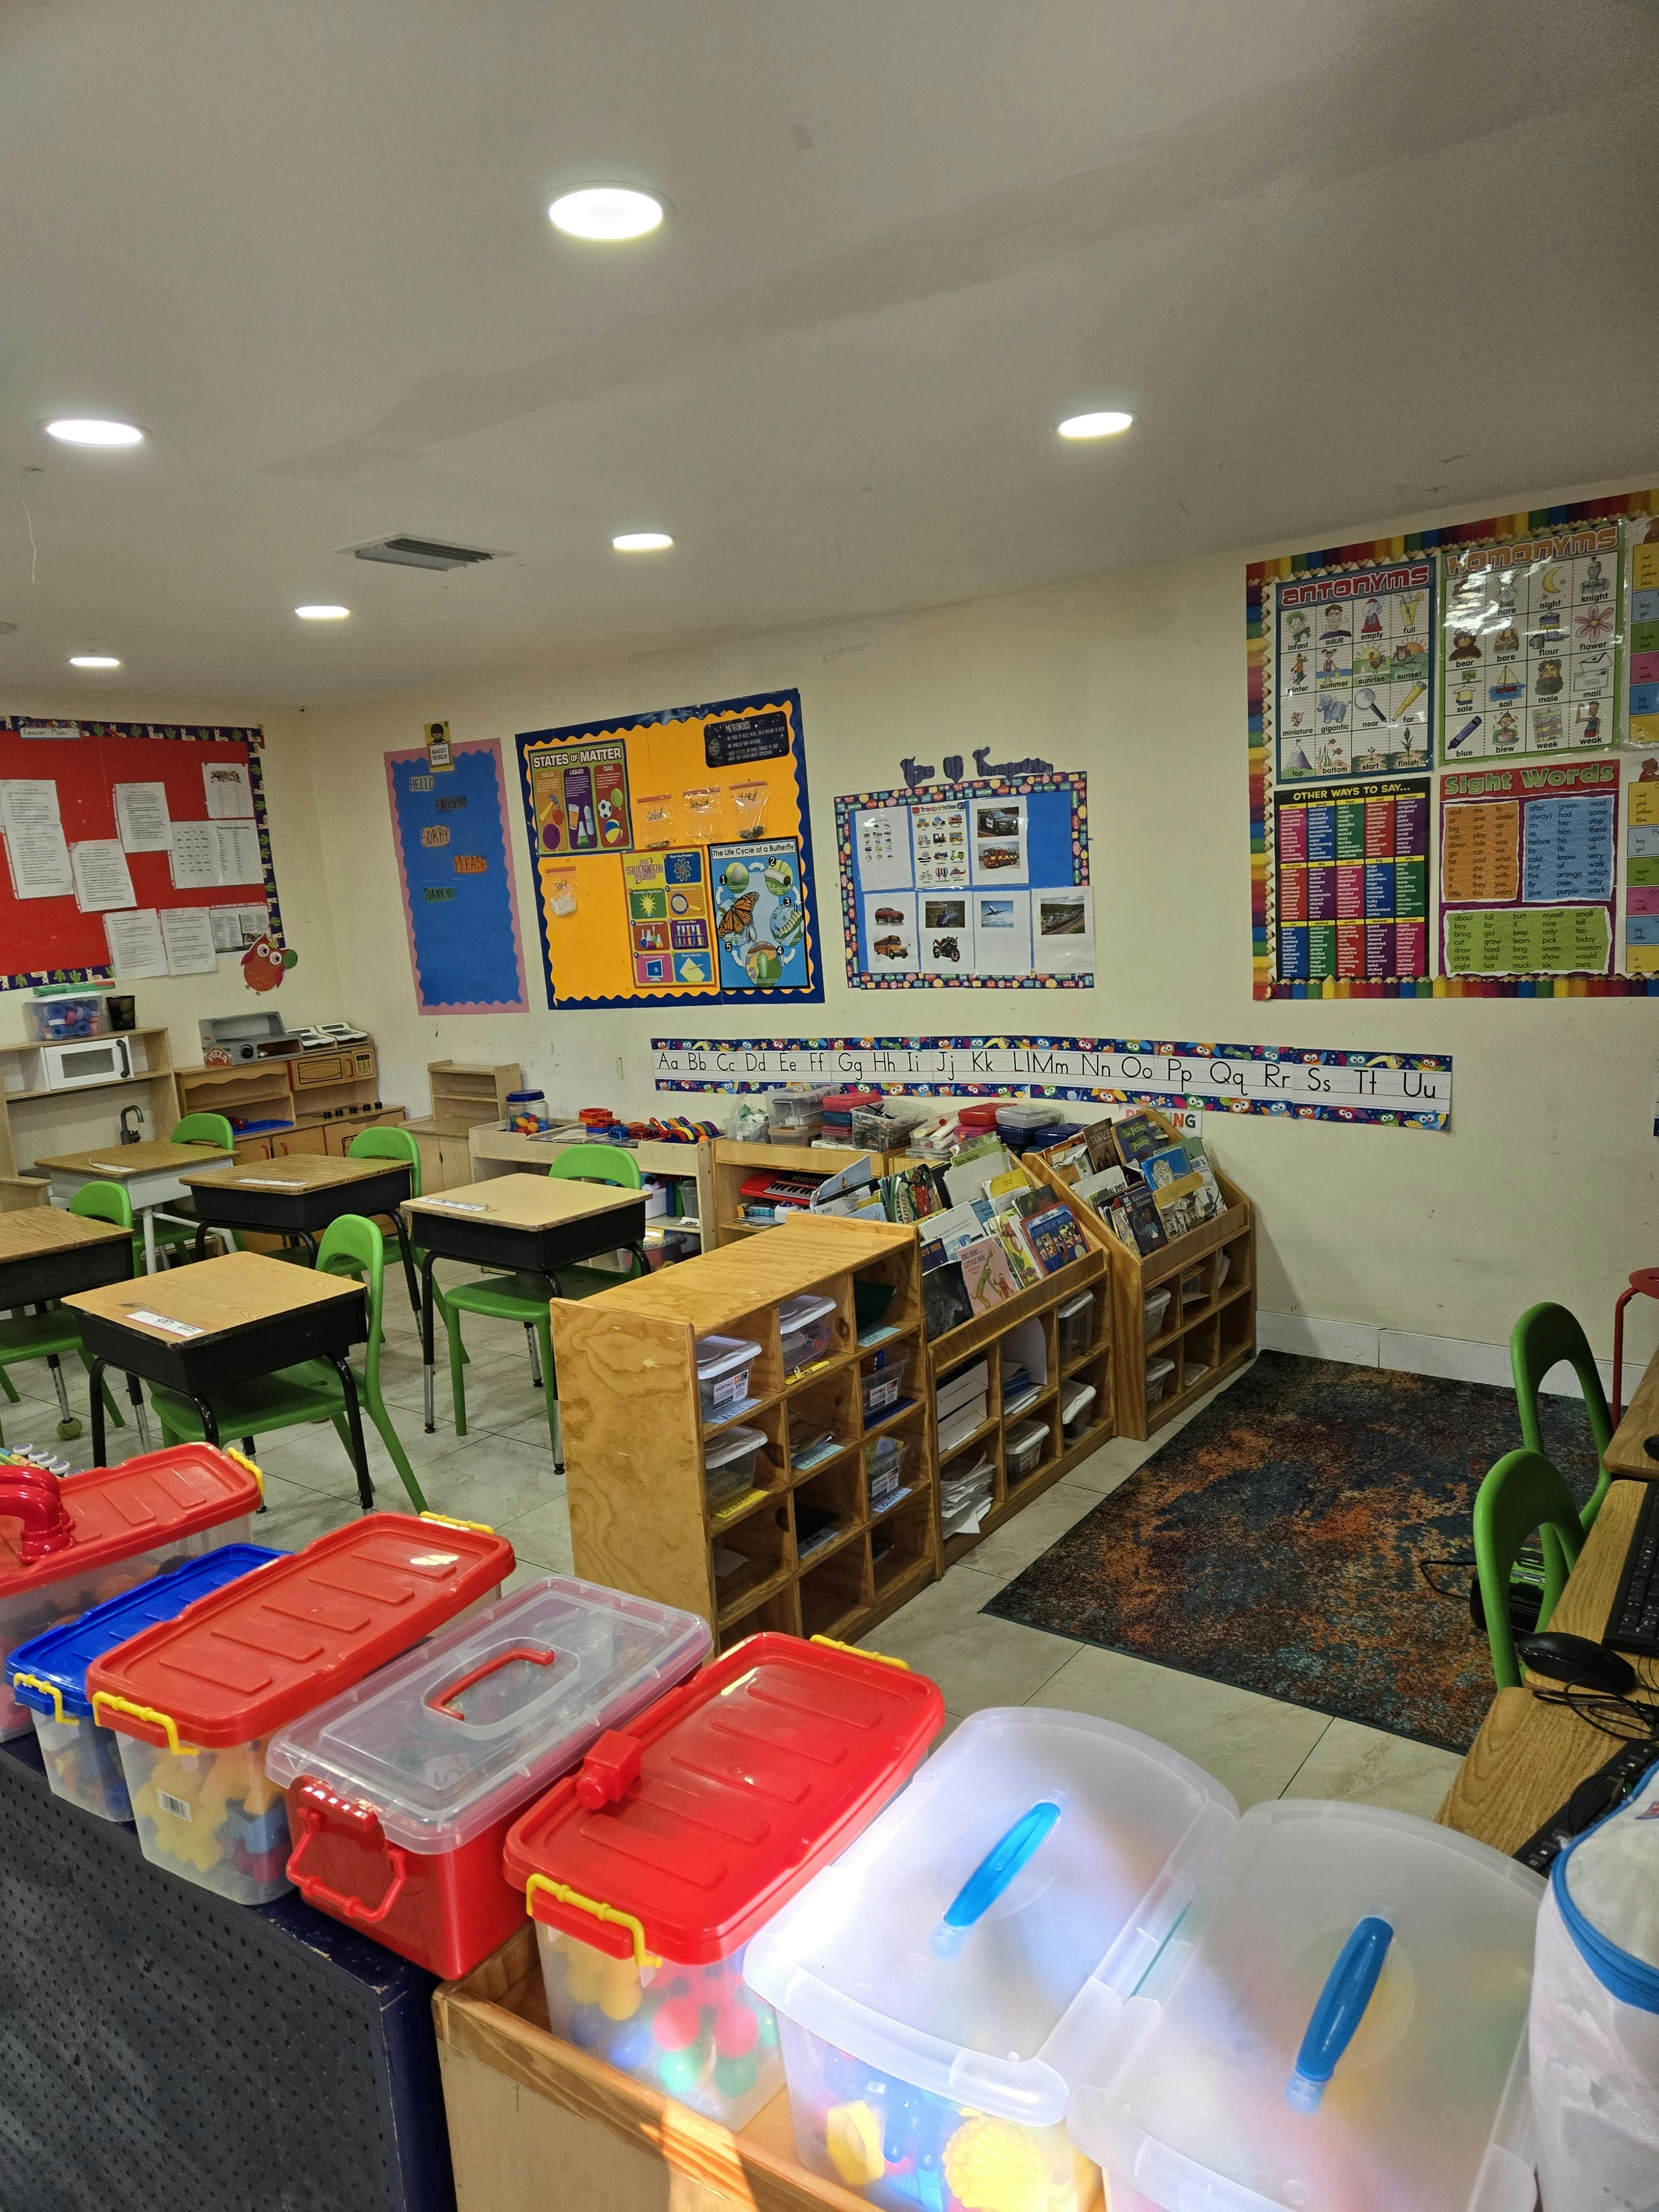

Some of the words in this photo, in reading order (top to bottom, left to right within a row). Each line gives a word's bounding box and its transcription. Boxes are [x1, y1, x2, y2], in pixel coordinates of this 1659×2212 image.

[1581, 593, 1609, 603] knight
[1540, 600, 1561, 611] night
[1361, 632, 1383, 640] empty
[1326, 637, 1344, 645] adult
[1580, 642, 1607, 651] flower
[1539, 648, 1559, 656] flour
[1497, 654, 1515, 662] bare
[1358, 676, 1385, 684] sunrise
[1397, 671, 1422, 680] sunset
[1320, 681, 1348, 690] summer
[1583, 690, 1601, 698] mail
[1538, 695, 1558, 703] male
[1282, 728, 1313, 736] miniature
[1321, 723, 1349, 733] gigantic
[534, 754, 568, 768] STATES
[580, 748, 621, 763] MATTER
[410, 778, 434, 790] HELLO
[1444, 771, 1512, 795] Sight
[1521, 764, 1614, 789] Words
[1293, 790, 1328, 801] OTHER
[1331, 786, 1359, 796] WAYS
[1363, 786, 1378, 794] TO
[1381, 784, 1410, 792] SAY...
[421, 827, 448, 846] SORRY
[769, 843, 794, 852] Butterfly
[454, 855, 487, 872] PLEASE
[770, 857, 775, 866] 2
[721, 875, 725, 884] 1
[423, 888, 445, 901] THANK
[785, 898, 790, 906] 3
[726, 943, 731, 951] 5
[777, 946, 782, 955] 4
[207, 1050, 228, 1063] PIZZA
[659, 1052, 679, 1070] Aa
[688, 1052, 706, 1071] Bb
[716, 1052, 735, 1071] Cc
[746, 1052, 766, 1071] Dd
[780, 1052, 797, 1071] Ee
[810, 1052, 823, 1071] Ff
[838, 1053, 863, 1081] Gg
[873, 1052, 895, 1072] Hh
[907, 1052, 919, 1072] Ii
[937, 1051, 954, 1081] Jj
[972, 1051, 993, 1072] Kk
[1013, 1051, 1030, 1072] Ll
[1033, 1052, 1068, 1074] Mm
[1082, 1054, 1110, 1077] Nn
[1121, 1056, 1152, 1079] Oo
[1168, 1058, 1192, 1092] Pp
[1210, 1061, 1248, 1096] Qq
[1265, 1063, 1290, 1087] Rr
[1308, 1067, 1331, 1092] Ss
[1354, 1070, 1377, 1095] Tt
[1403, 1072, 1436, 1098] Uu
[931, 1242, 942, 1251] TREE
[961, 1252, 969, 1260] BIG
[963, 1259, 977, 1269] LITTLE
[977, 1254, 985, 1264] DOG
